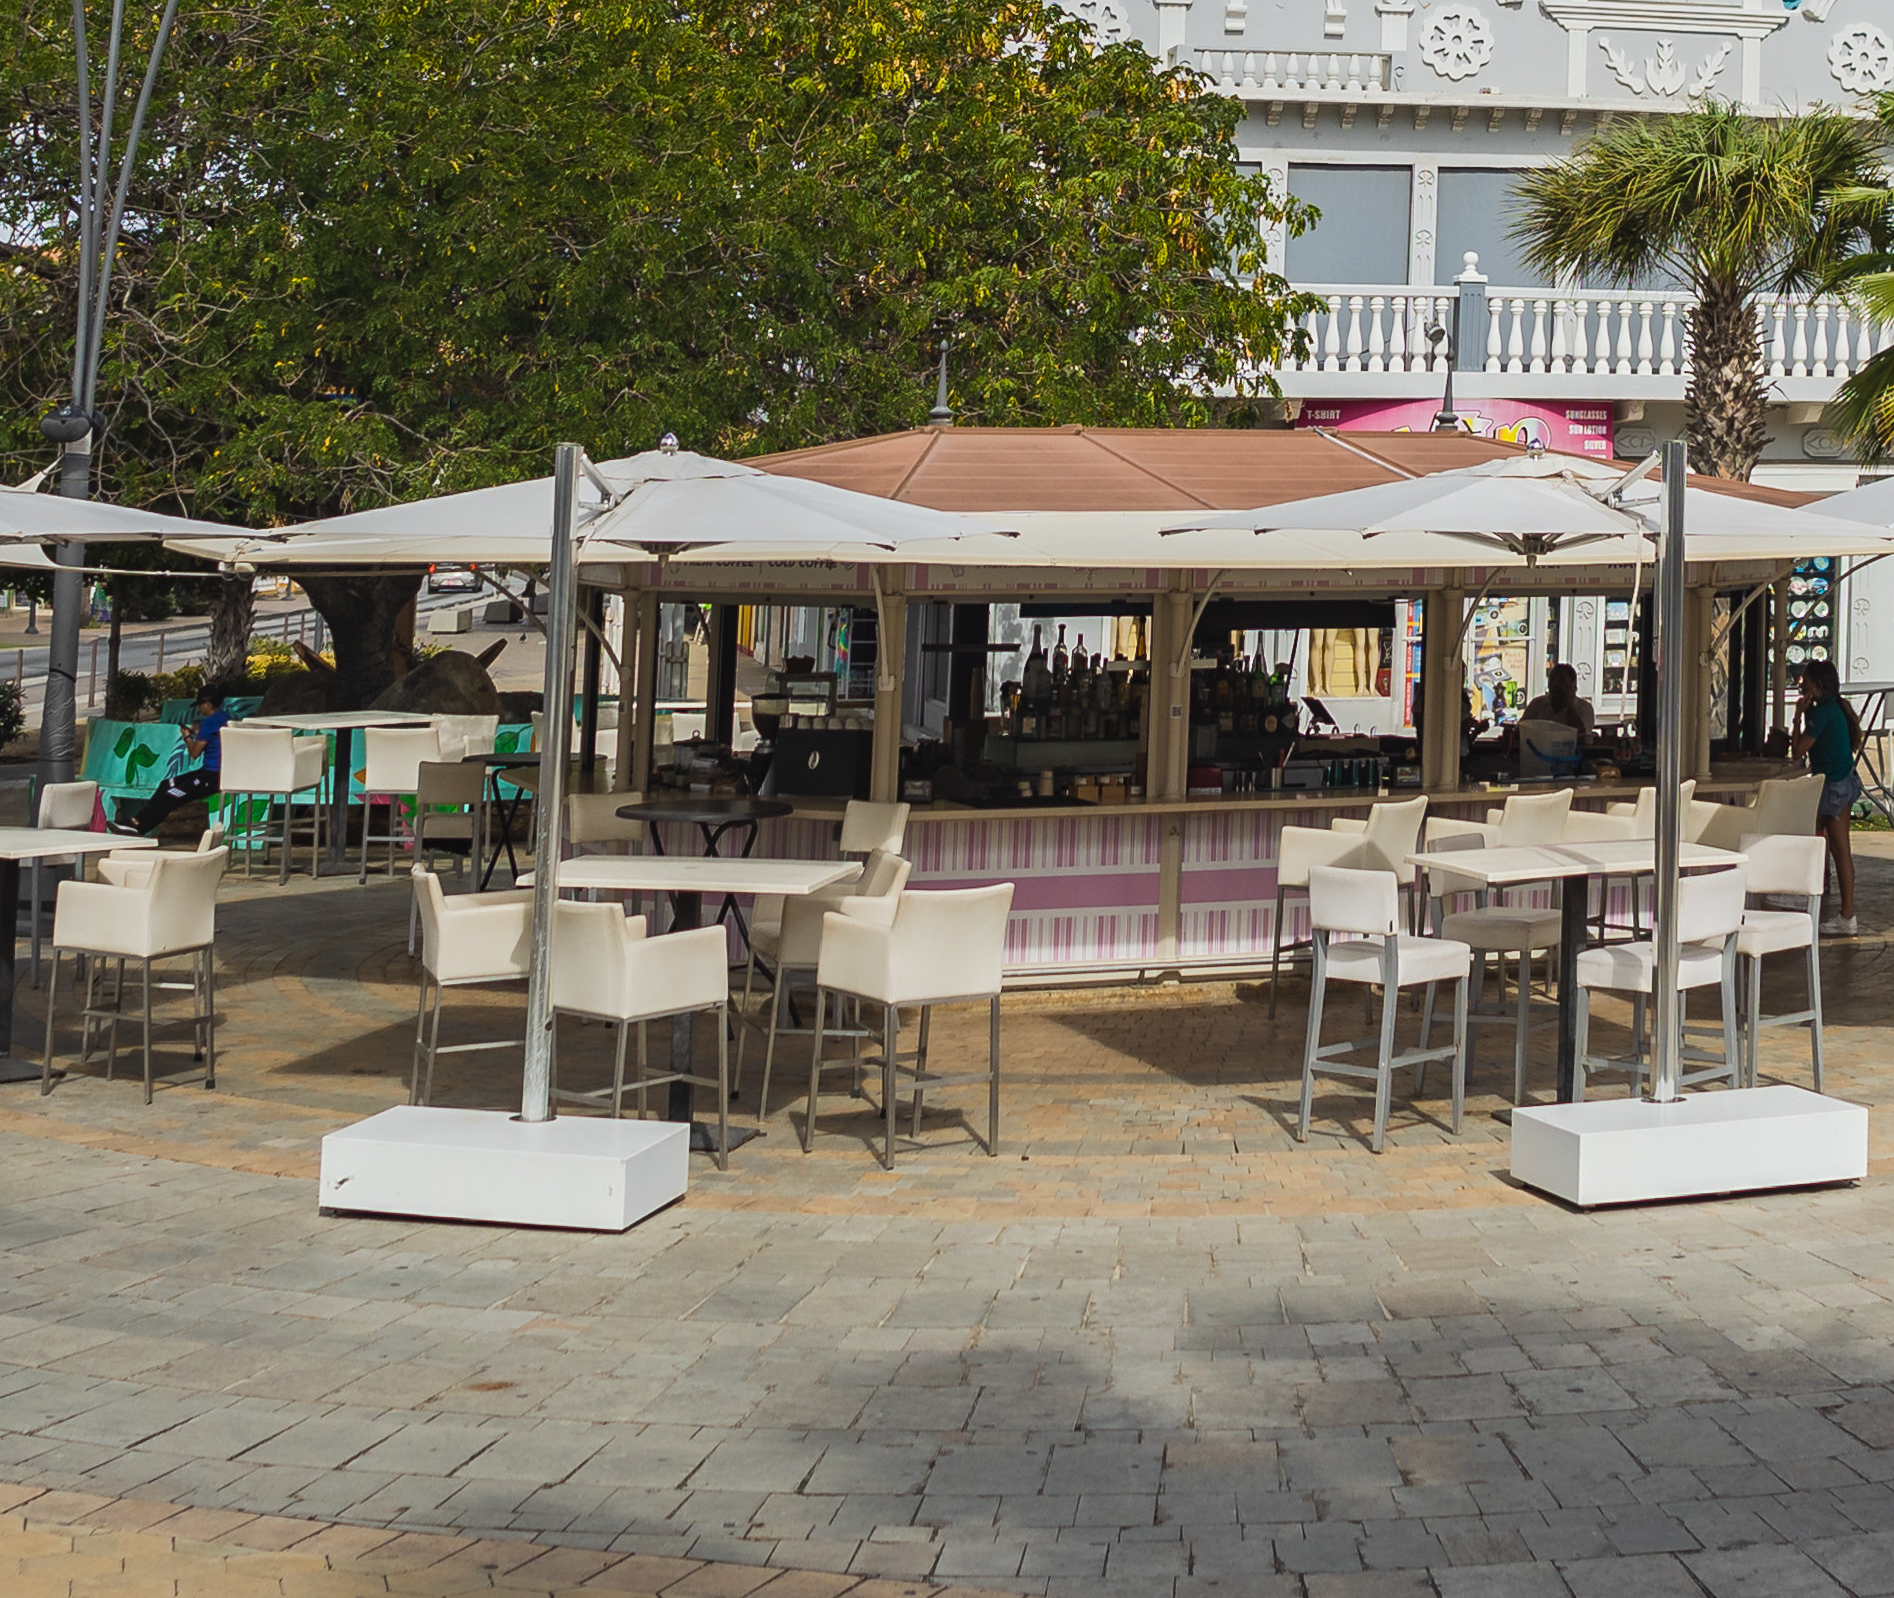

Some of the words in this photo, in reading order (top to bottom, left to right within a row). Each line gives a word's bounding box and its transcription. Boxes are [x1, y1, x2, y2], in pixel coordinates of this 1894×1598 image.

[1306, 409, 1341, 420] T-SHIRT
[1565, 409, 1607, 420] SUNGLASSES
[1568, 424, 1583, 435] SUN
[1584, 425, 1607, 435] LOTION
[1584, 440, 1607, 450] SILVER
